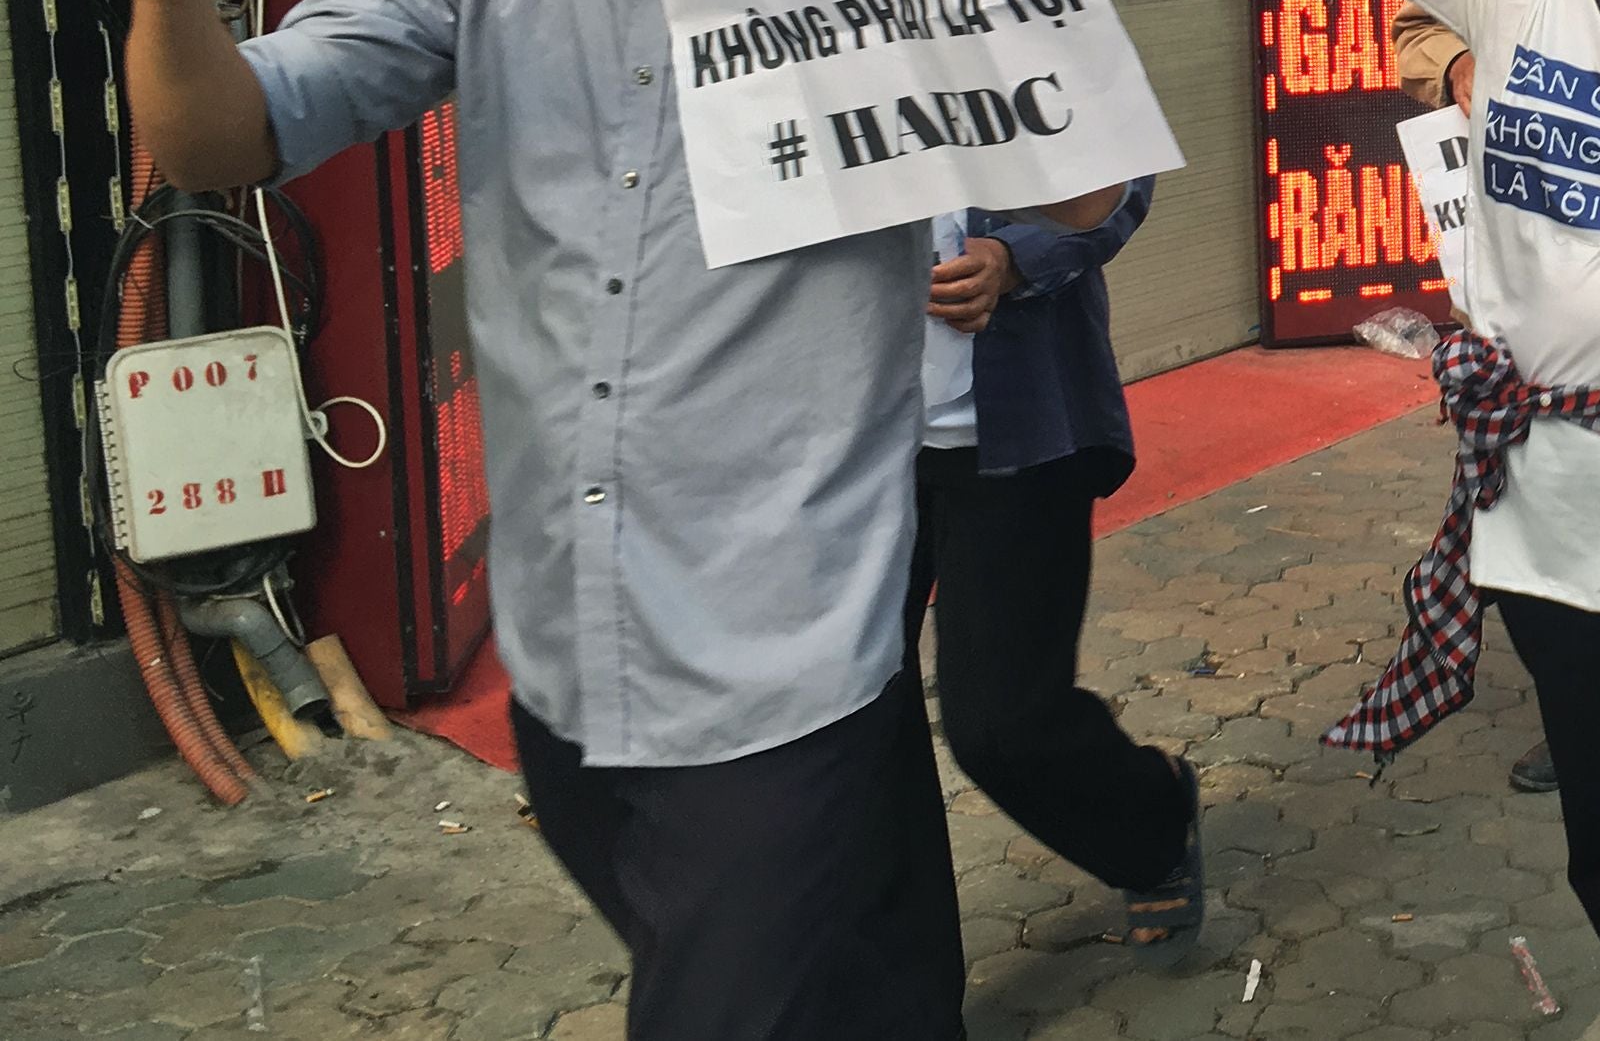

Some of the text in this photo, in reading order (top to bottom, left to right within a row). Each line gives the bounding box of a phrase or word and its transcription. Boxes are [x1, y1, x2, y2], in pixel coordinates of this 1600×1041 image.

[689, 5, 838, 89] KHÔNG
[826, 73, 1074, 170] HAEDC
[1539, 179, 1600, 223] TỘI
